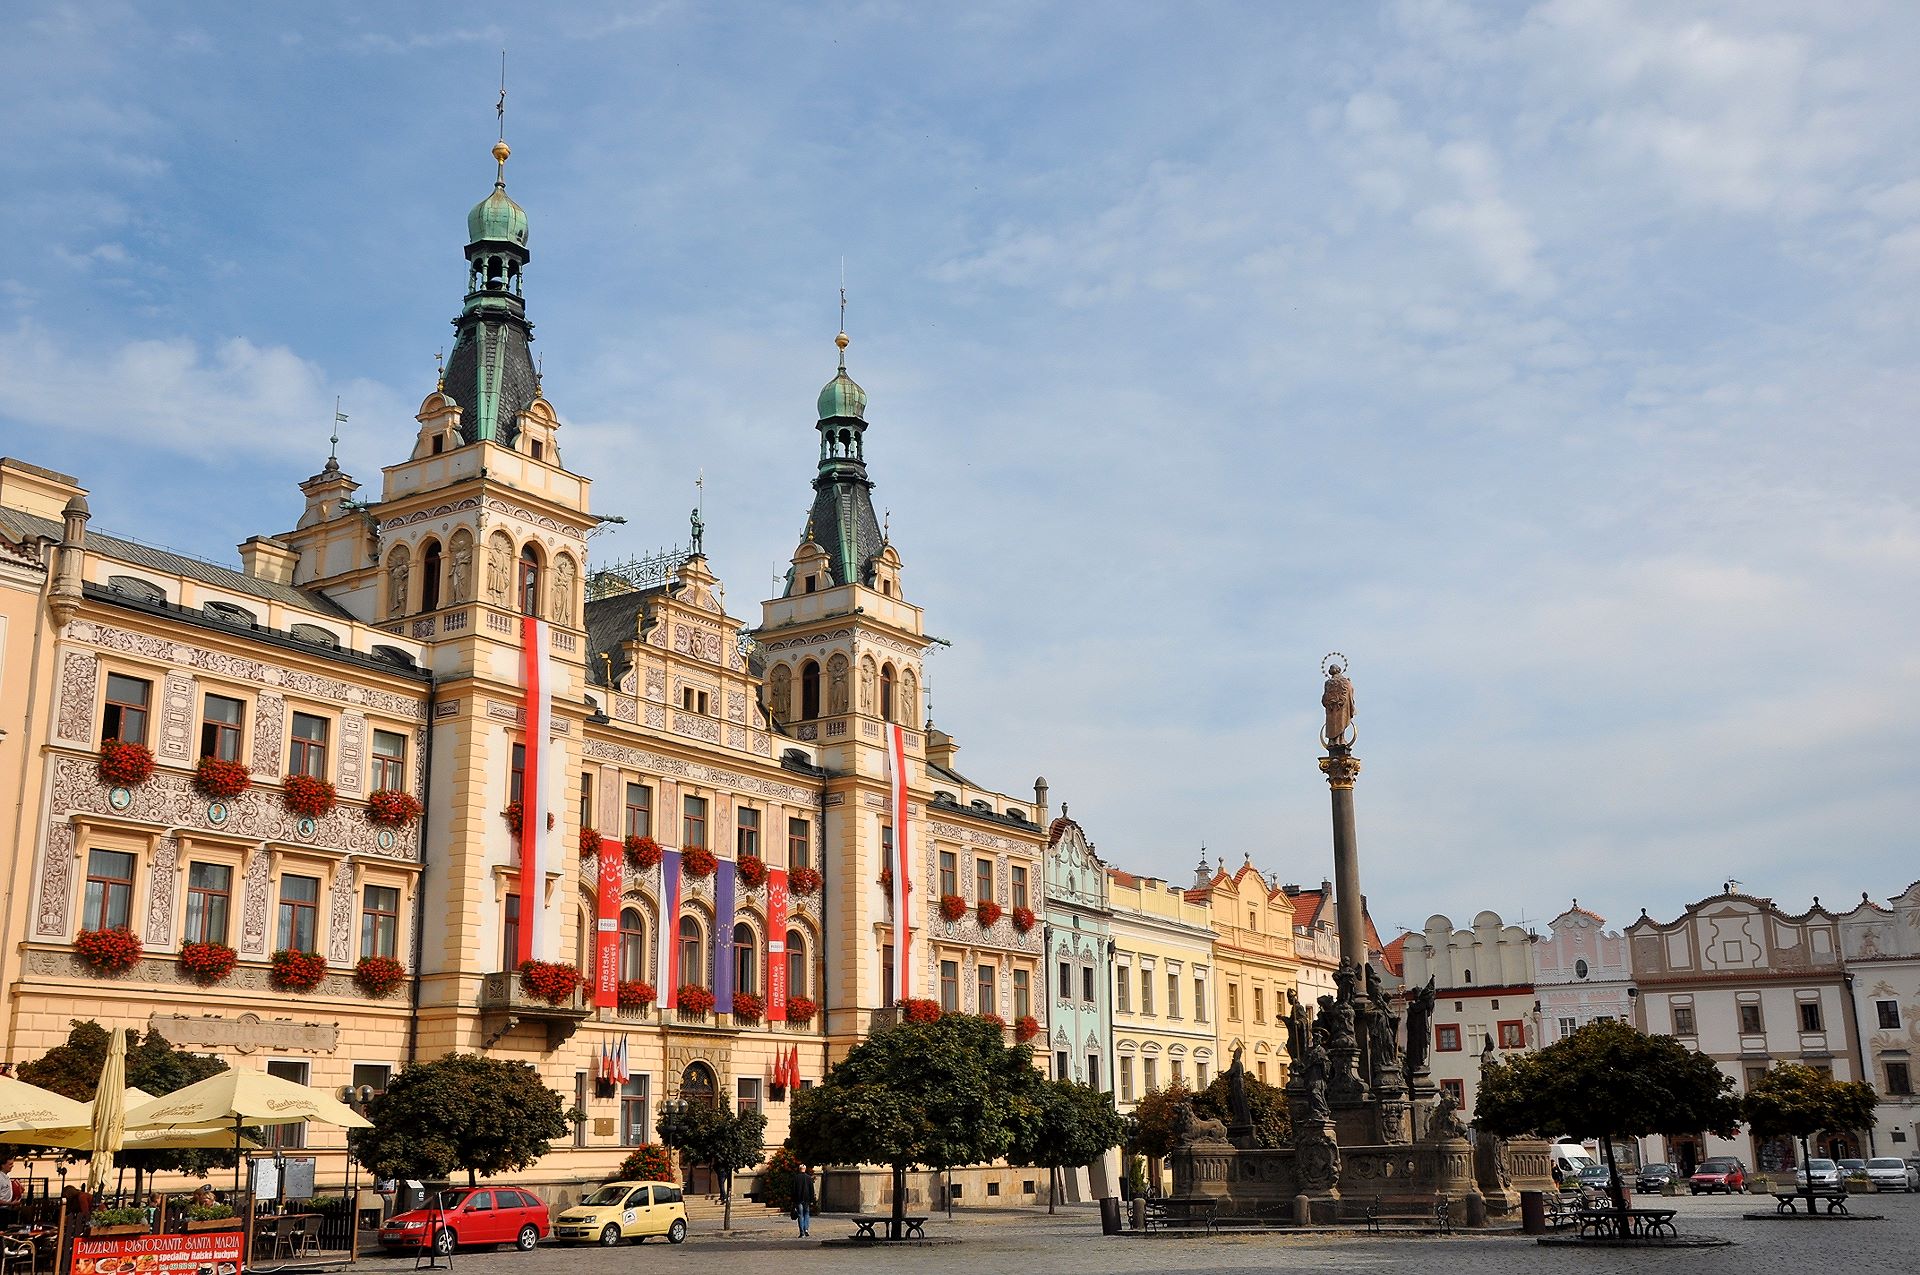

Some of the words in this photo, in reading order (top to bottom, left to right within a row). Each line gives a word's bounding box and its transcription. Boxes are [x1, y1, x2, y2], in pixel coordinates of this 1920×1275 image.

[78, 1241, 119, 1254] PIZZERIA
[125, 1238, 183, 1252] RISTORANTE
[185, 1237, 211, 1250] SANTA
[215, 1236, 240, 1248] MARIA
[159, 1251, 190, 1262] speciality
